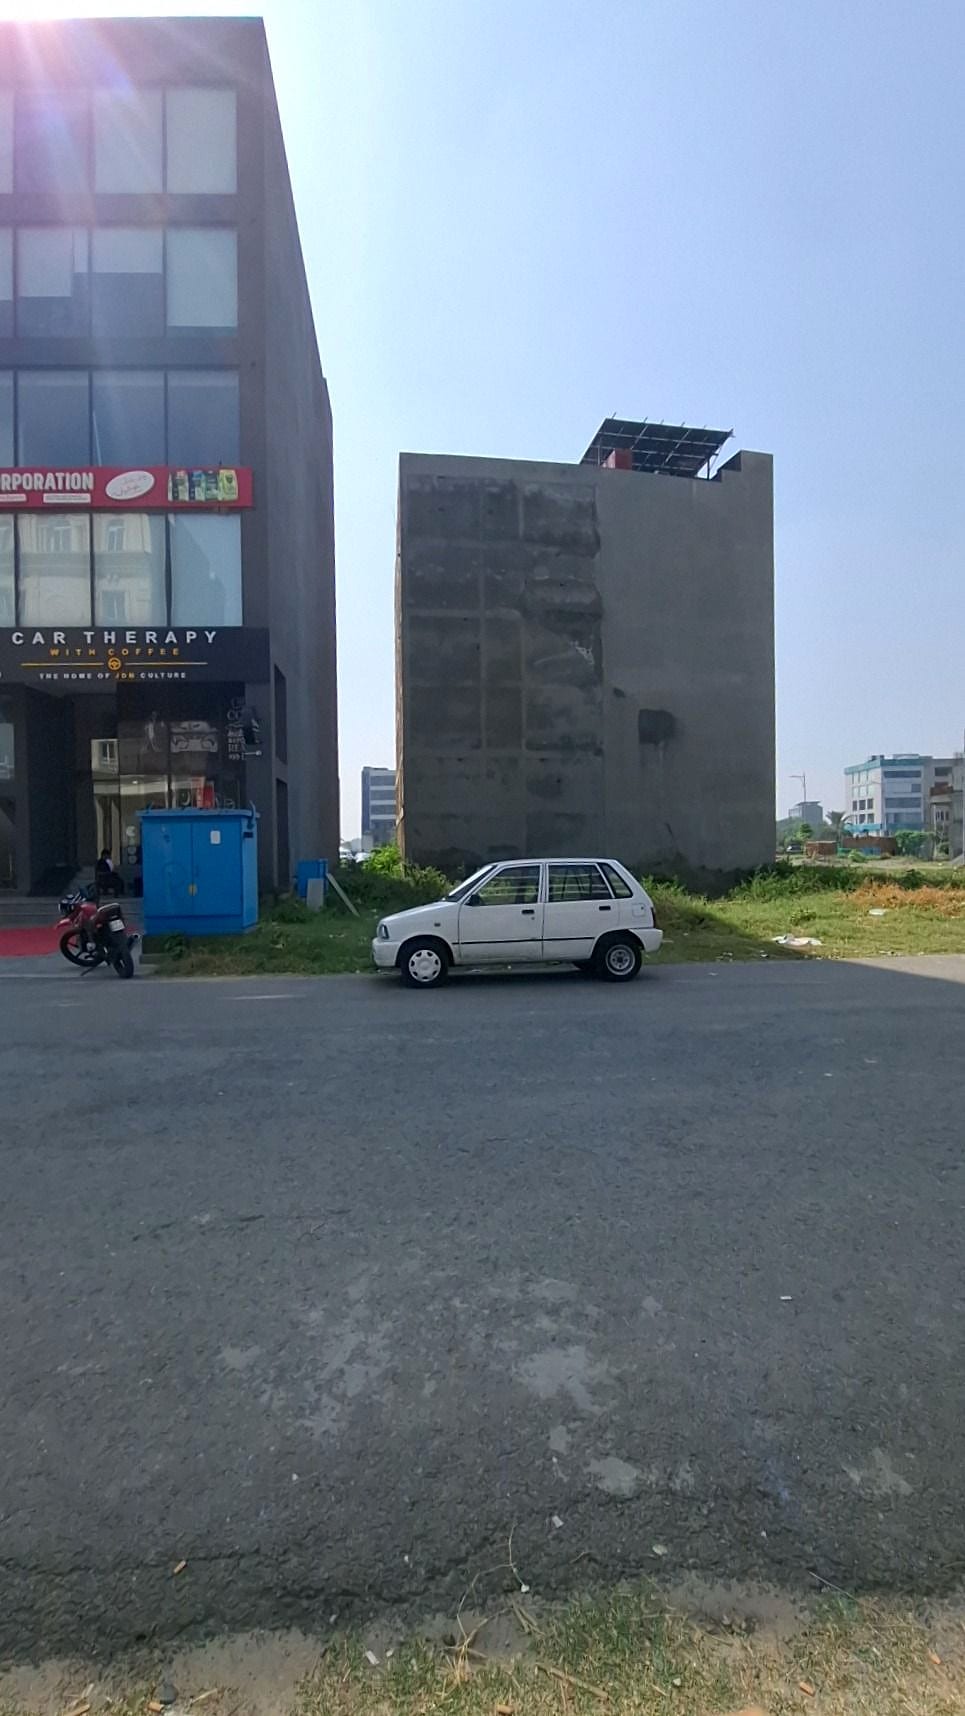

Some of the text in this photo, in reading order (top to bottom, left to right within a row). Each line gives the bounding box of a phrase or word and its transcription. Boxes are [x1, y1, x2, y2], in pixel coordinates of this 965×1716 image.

[12, 631, 217, 644] CAR THERAPY
[49, 647, 180, 657] WITH COFFEE
[39, 672, 59, 680] THE
[63, 672, 92, 680] HOME
[97, 672, 110, 680] OF
[140, 671, 187, 680] CULTURE
